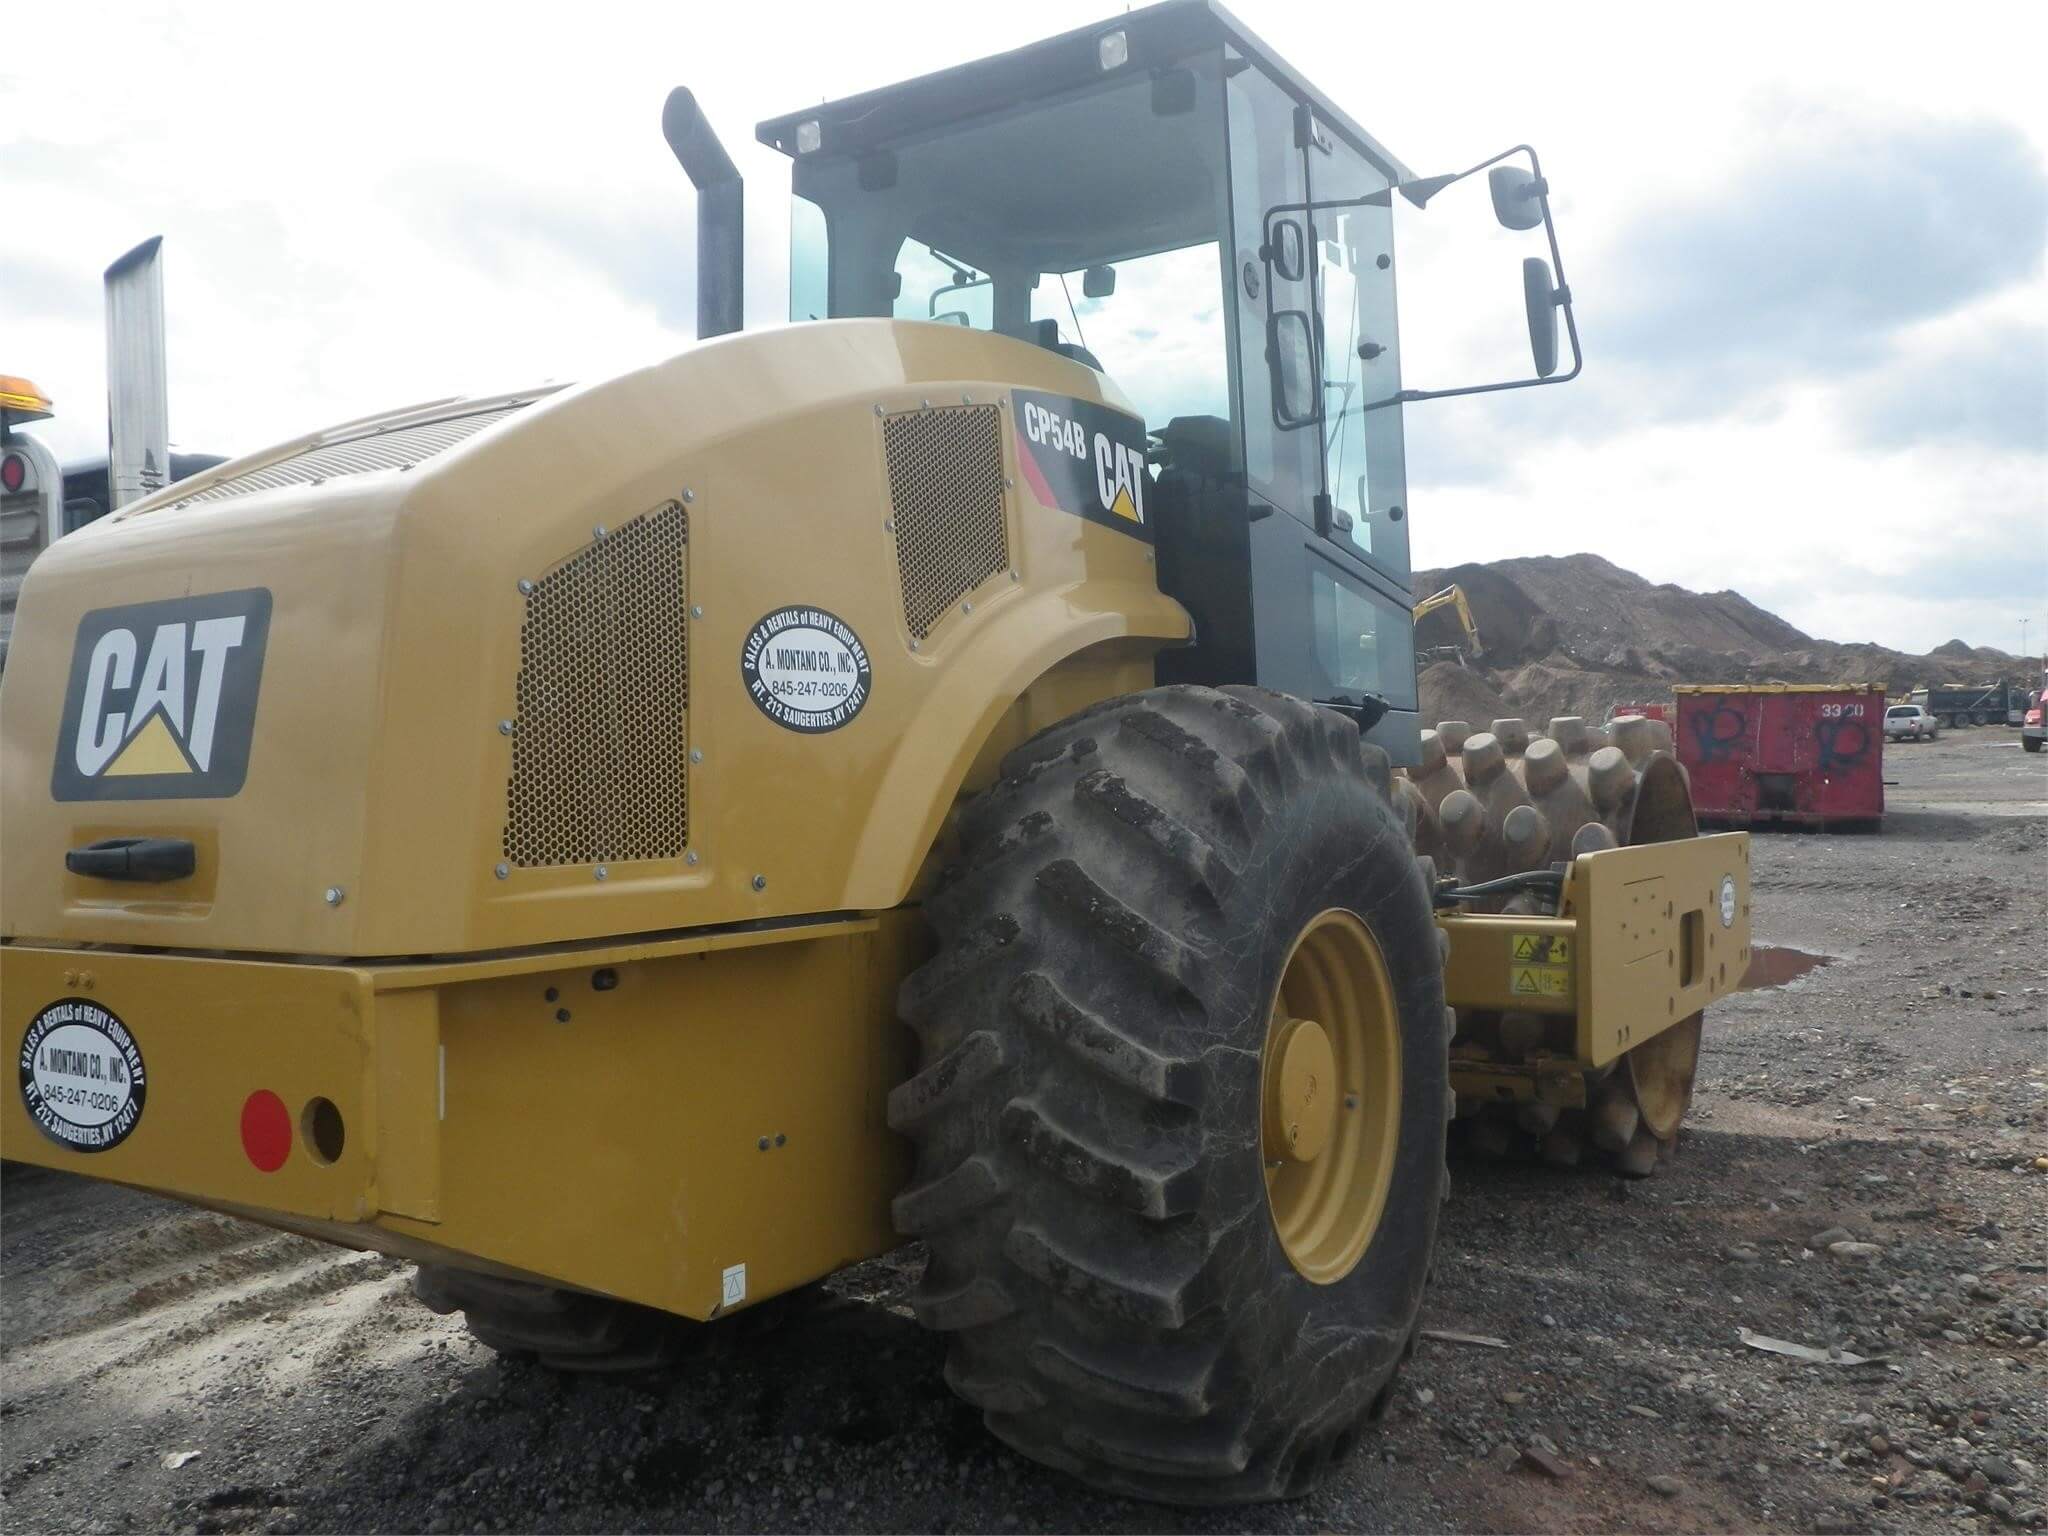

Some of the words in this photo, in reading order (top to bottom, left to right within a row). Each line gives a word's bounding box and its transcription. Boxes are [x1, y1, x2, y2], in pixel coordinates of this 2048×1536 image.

[1024, 401, 1087, 460] CP54B
[1093, 432, 1145, 525] CAT
[744, 632, 763, 670] SALES
[760, 624, 769, 639] &
[767, 610, 799, 633] RENTALS
[800, 611, 808, 625] of
[809, 611, 834, 631] HEAVY
[834, 621, 869, 673] EQUIPMENT
[765, 647, 775, 670] A.
[776, 648, 817, 671] MONTANO
[818, 650, 836, 676] CO.,
[837, 651, 854, 673] INC.
[75, 615, 247, 777] CAT
[751, 679, 766, 702] RT.
[765, 695, 783, 718] 212
[845, 683, 865, 713] 12477
[772, 680, 848, 697] 845-247-0206
[21, 1029, 39, 1070] SALES
[37, 1020, 45, 1035] &
[42, 1004, 73, 1025] RENTALS
[74, 1005, 83, 1021] of
[83, 1005, 108, 1028] HEAVY
[107, 1020, 144, 1085] EQUIPMENT
[39, 1047, 48, 1072] A.
[49, 1048, 87, 1078] MONTANO
[89, 1053, 108, 1086] CO.,
[109, 1056, 127, 1084] INC.
[25, 1081, 40, 1106] RT.
[34, 1101, 52, 1127] 212
[114, 1097, 138, 1134] 12477
[43, 1083, 119, 1113] 845-247-0206
